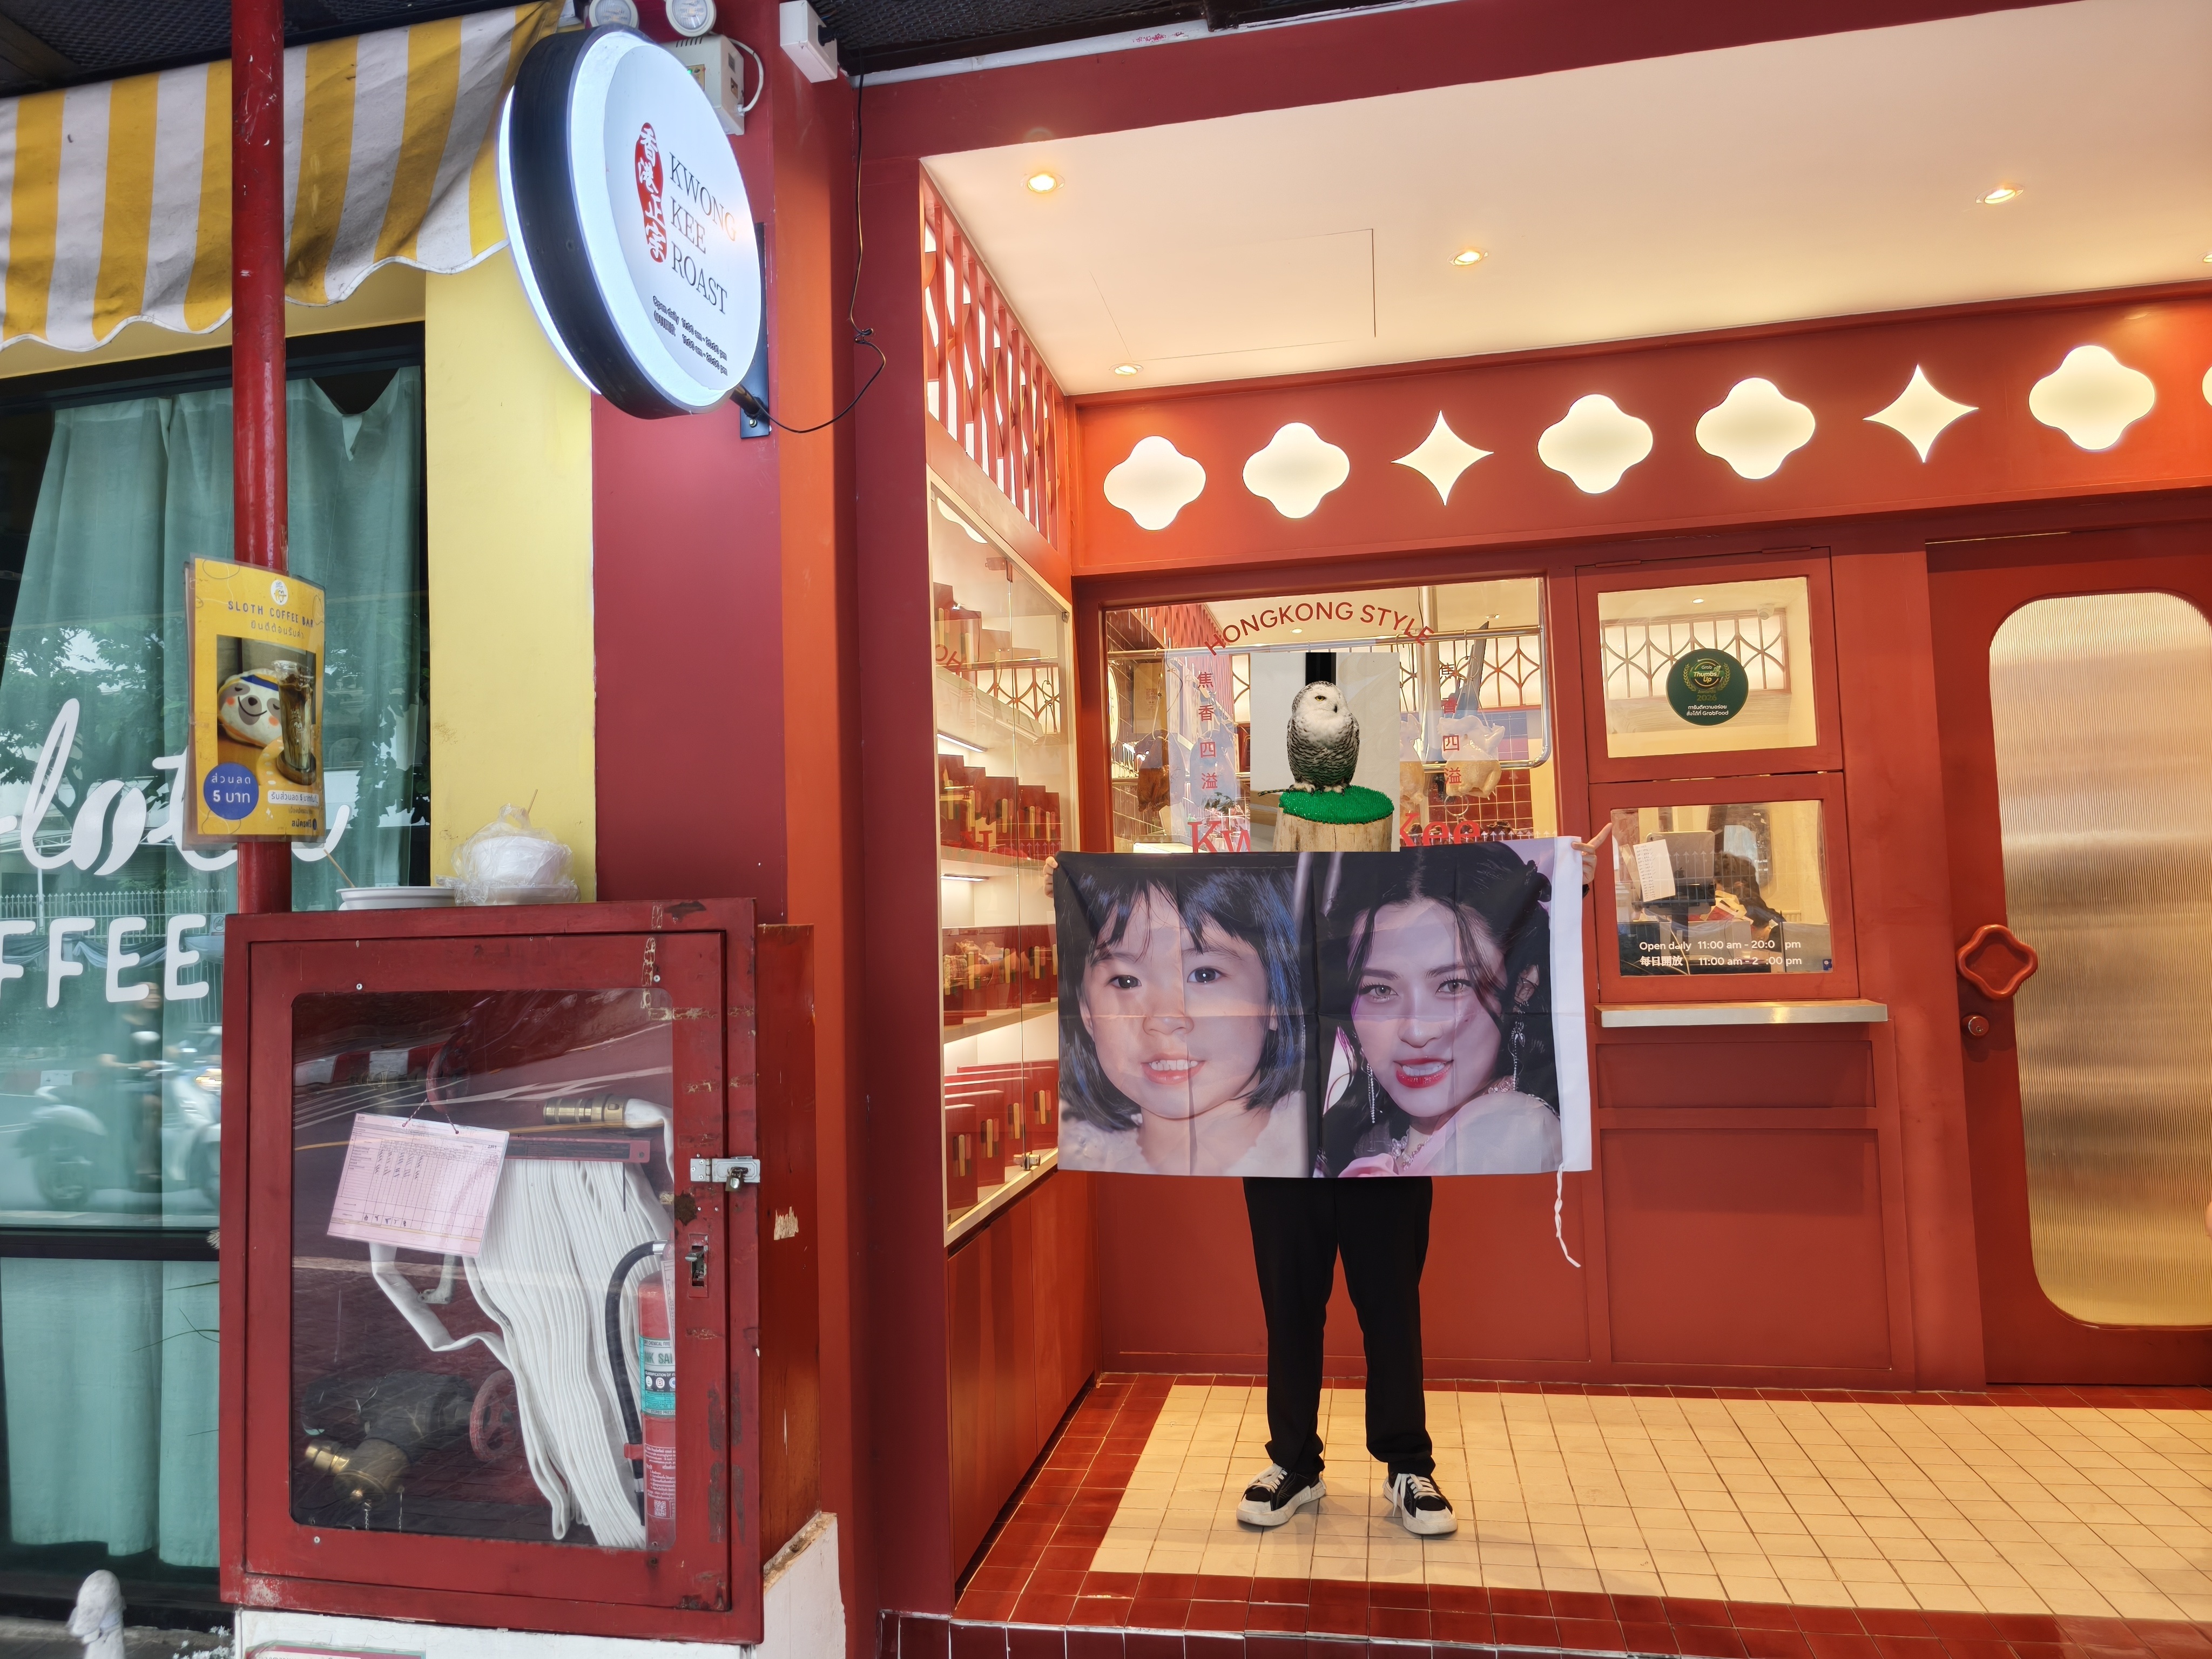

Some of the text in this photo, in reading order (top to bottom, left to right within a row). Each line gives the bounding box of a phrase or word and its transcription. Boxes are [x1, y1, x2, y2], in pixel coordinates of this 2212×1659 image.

[669, 152, 737, 241] KWONG
[671, 196, 706, 254] KEE
[671, 241, 727, 314] ROAST
[653, 295, 667, 315] Open
[228, 601, 314, 629] SLOTH COFFEE BAR
[1204, 602, 1435, 656] HONGKONG STYLE
[1197, 671, 1218, 790] 焦香四溢
[211, 772, 251, 784] ส่วนลด
[213, 790, 251, 804] 5 บาท
[1639, 942, 1666, 952] Open
[1668, 941, 1691, 951] daily
[1697, 941, 1724, 949] 11:00
[1751, 940, 1775, 949] 20:0
[1784, 941, 1801, 950] pm
[1640, 955, 1683, 967] 每日開放
[1698, 957, 1725, 966] 11:00
[1785, 958, 1802, 967] pm
